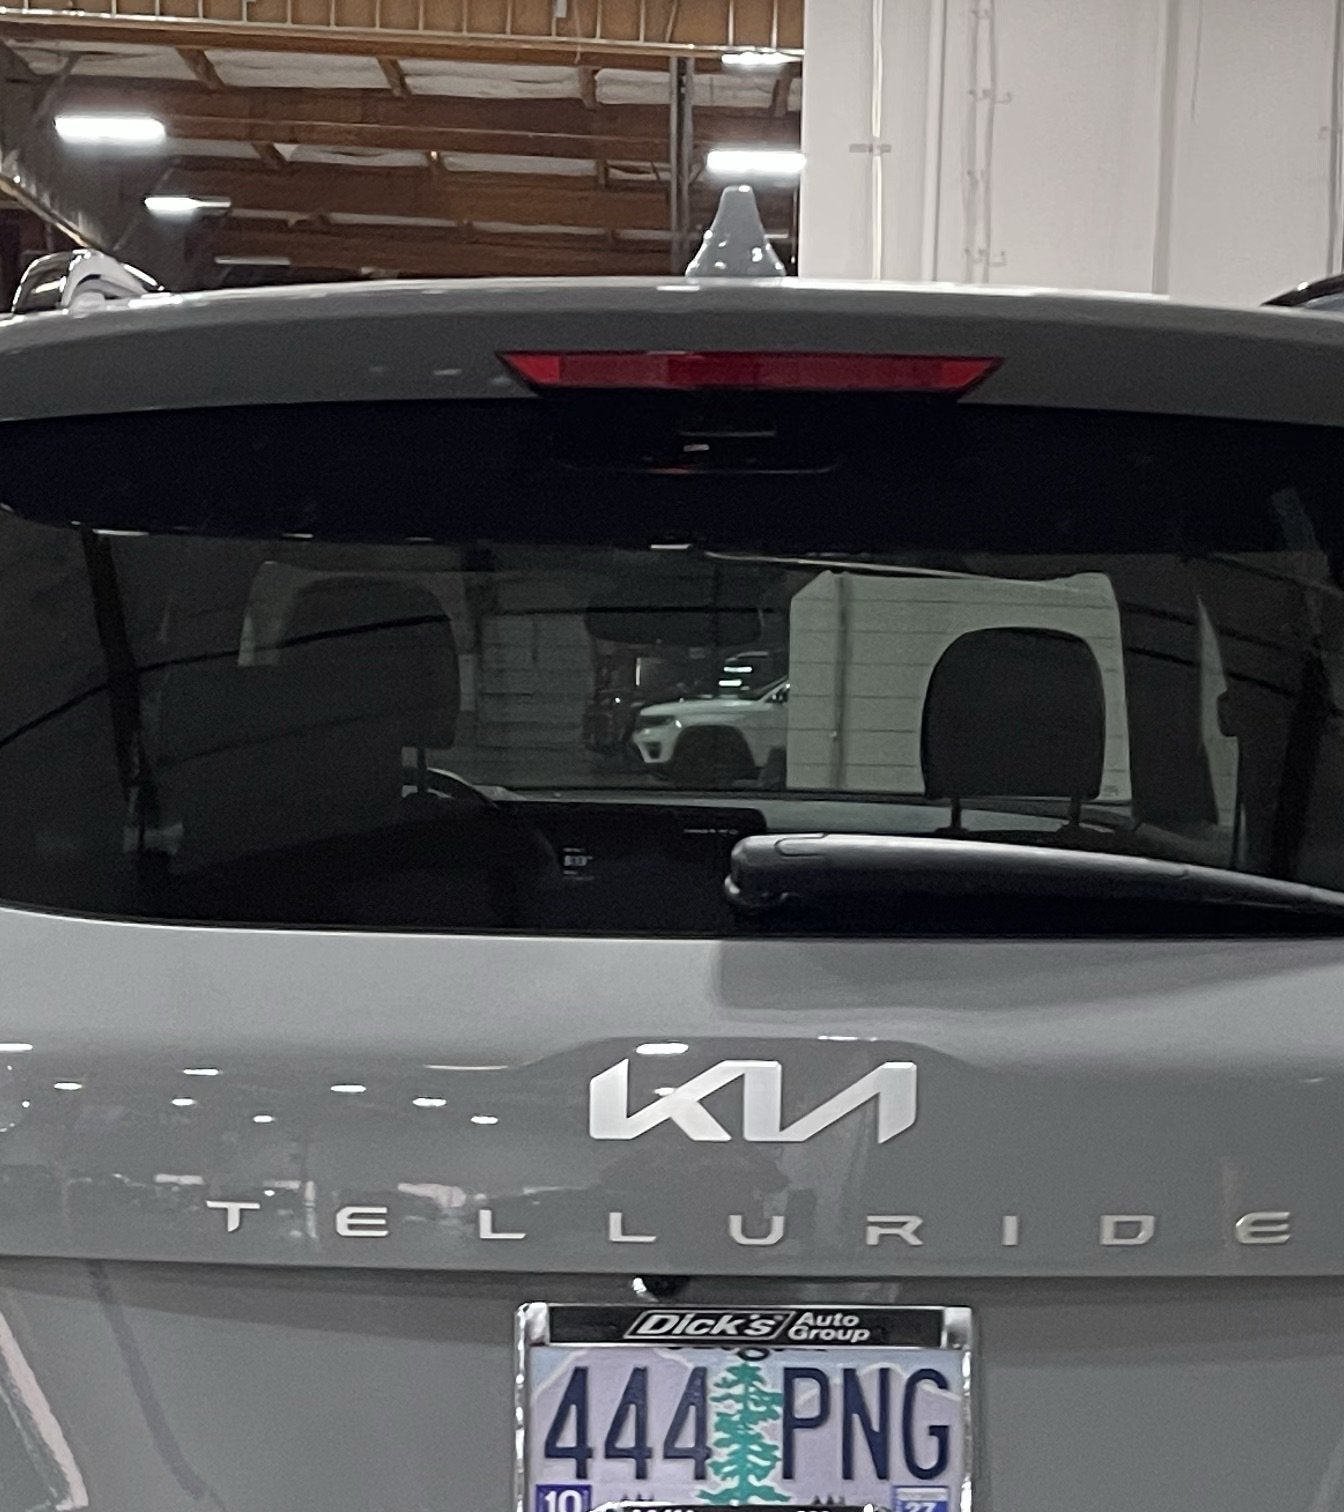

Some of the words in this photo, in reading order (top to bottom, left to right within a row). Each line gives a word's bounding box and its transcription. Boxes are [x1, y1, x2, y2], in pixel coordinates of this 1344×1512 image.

[588, 1058, 918, 1143] KIA
[205, 1199, 1292, 1247] TELLURIDE
[636, 1313, 778, 1336] Dick's
[787, 1325, 871, 1343] Group
[795, 1311, 860, 1327] Auto
[543, 1366, 714, 1480] 444
[782, 1366, 951, 1480] PNG
